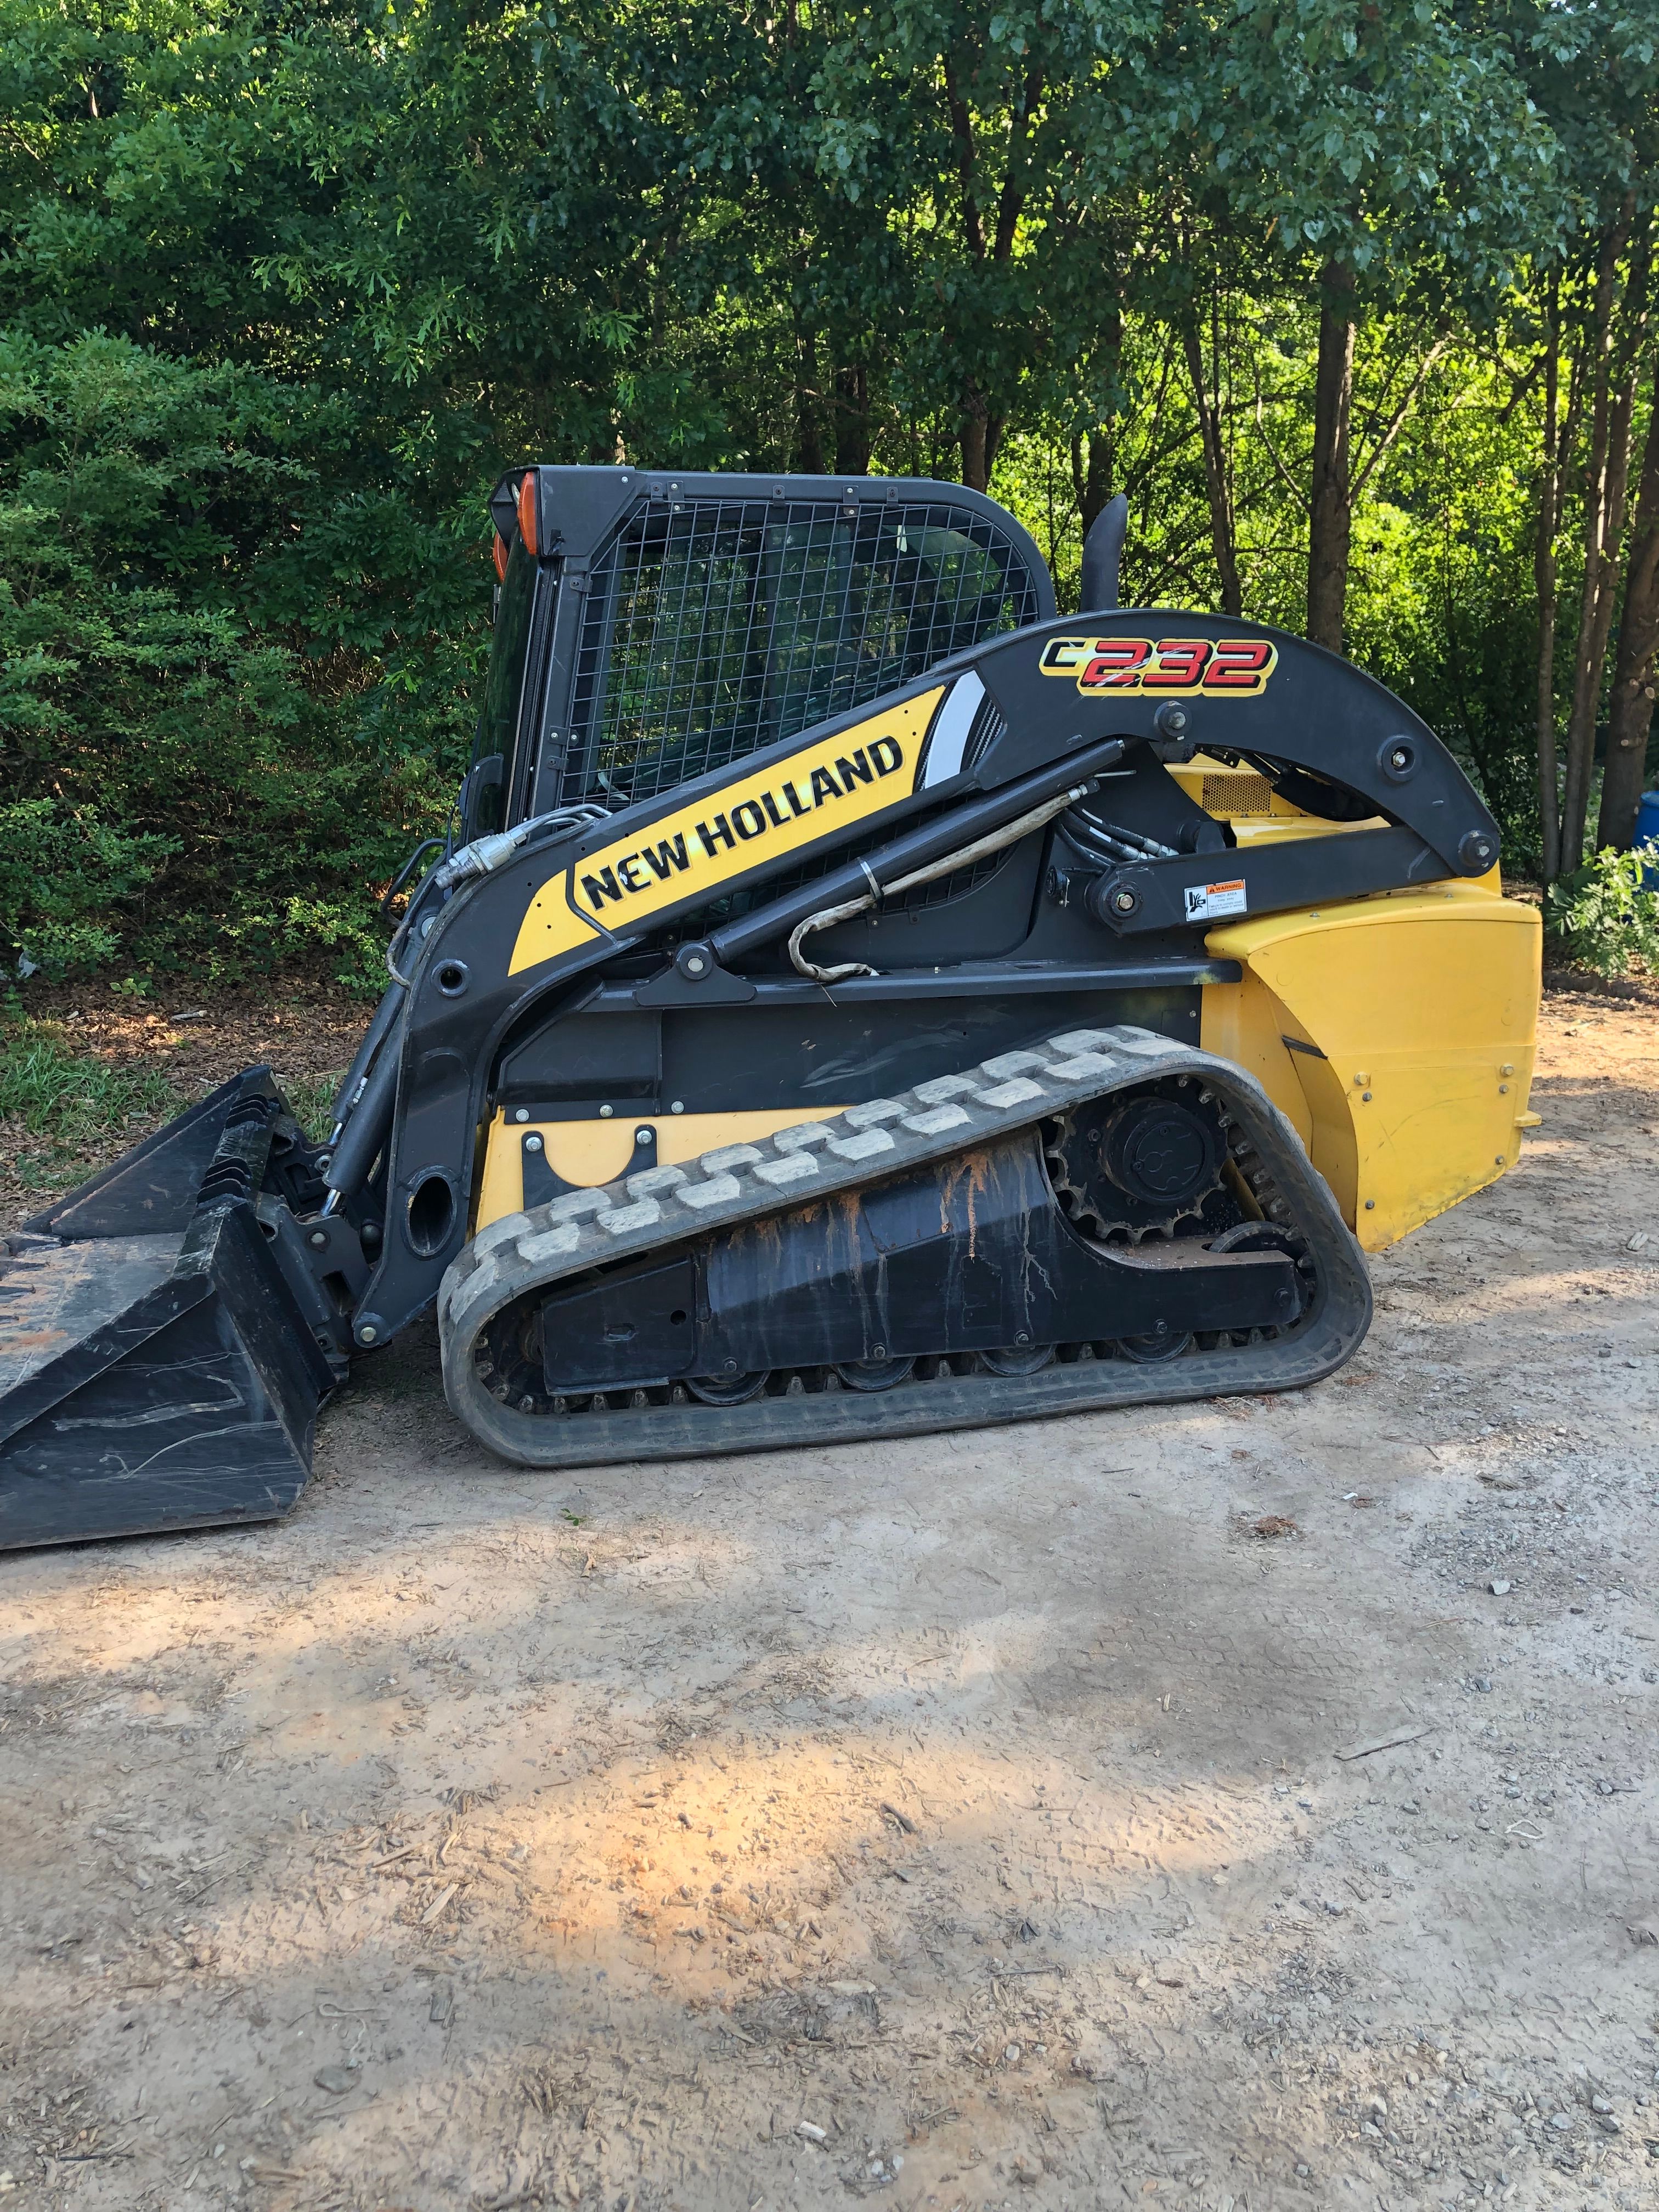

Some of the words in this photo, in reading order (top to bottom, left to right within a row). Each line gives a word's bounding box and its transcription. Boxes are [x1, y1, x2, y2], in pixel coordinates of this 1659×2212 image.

[1042, 640, 1273, 689] C232
[580, 831, 691, 911] NEW
[695, 735, 904, 859] HOLLAND
[1216, 883, 1242, 891] WARNING
